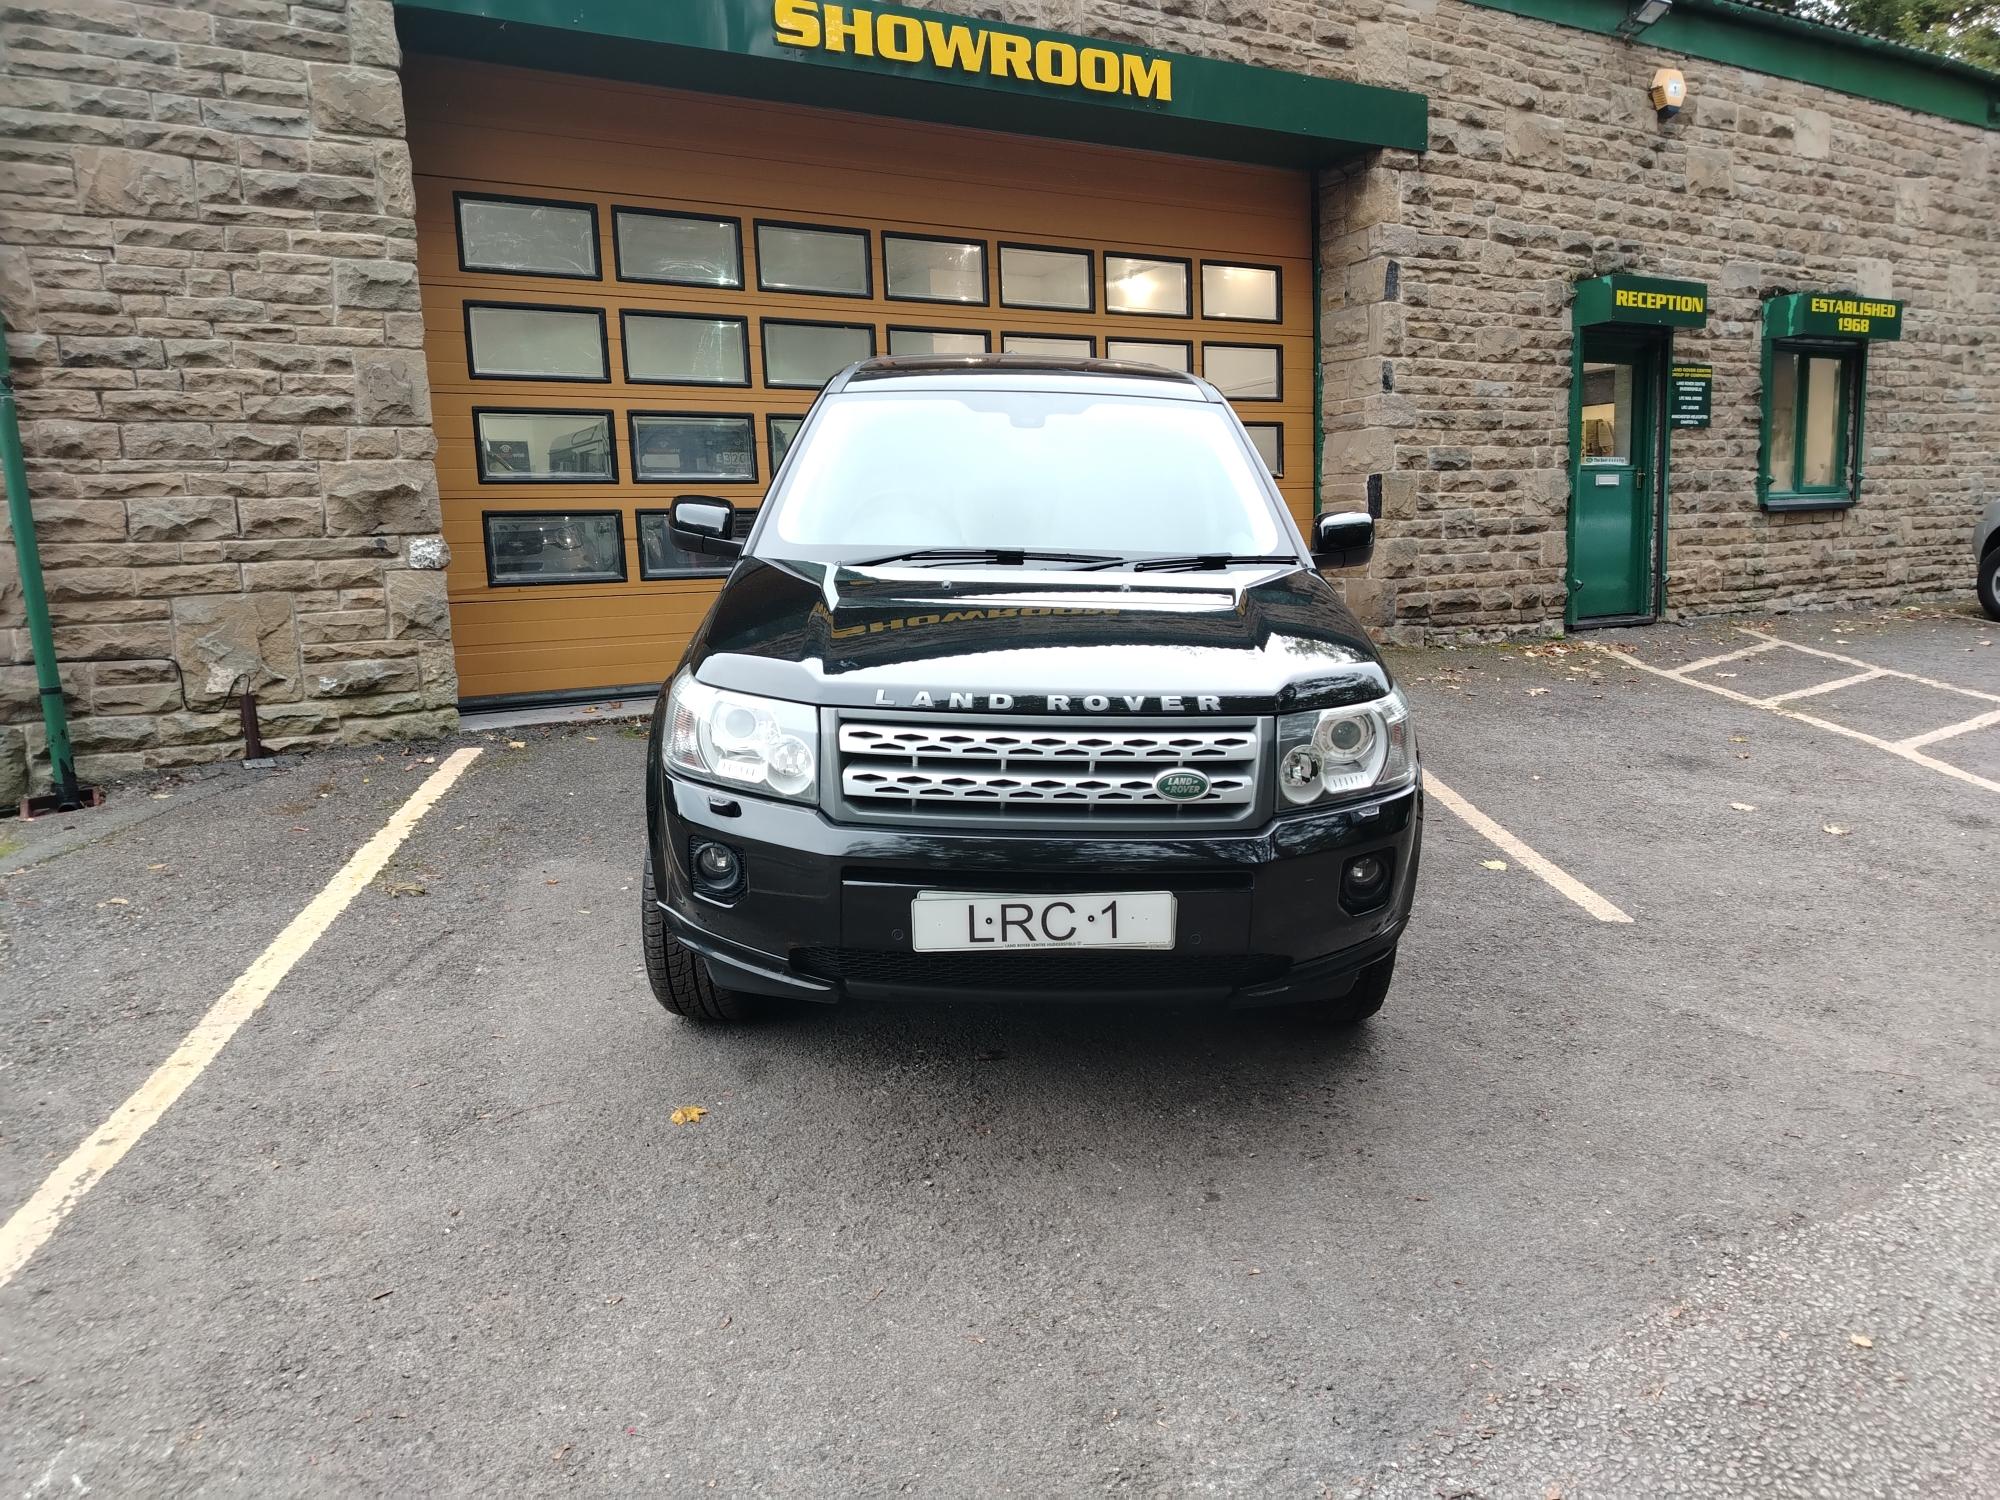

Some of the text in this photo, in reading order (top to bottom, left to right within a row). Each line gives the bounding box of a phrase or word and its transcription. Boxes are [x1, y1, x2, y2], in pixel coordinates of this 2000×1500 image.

[774, 0, 1172, 102] SHOWROOM
[1615, 289, 1703, 313] RECEPTION
[1811, 298, 1896, 318] ESTABLISHED
[1837, 317, 1870, 333] 1968
[874, 689, 1223, 712] LAND ROVER
[1168, 777, 1192, 786] LAND
[1170, 785, 1201, 794] ROVER
[968, 900, 1118, 943] LRC 1
